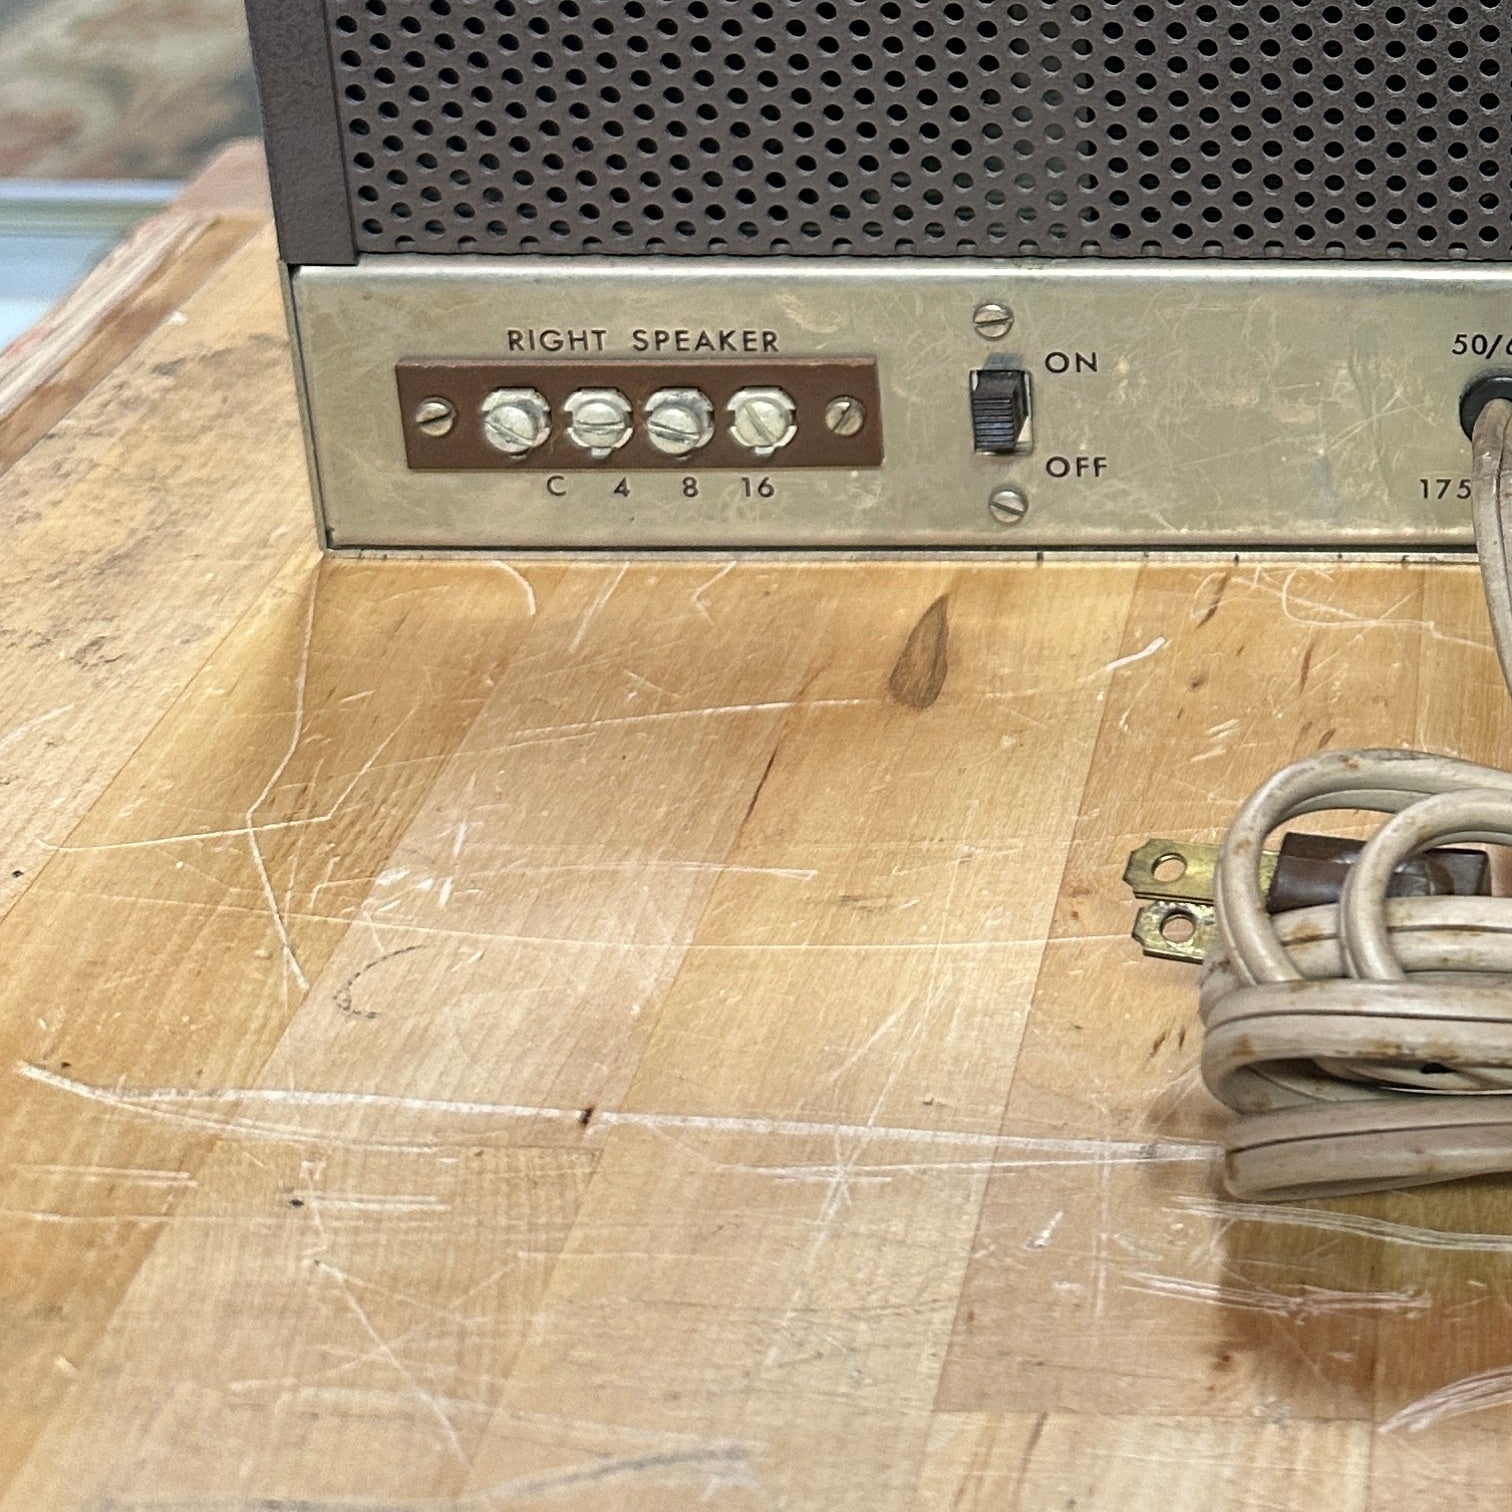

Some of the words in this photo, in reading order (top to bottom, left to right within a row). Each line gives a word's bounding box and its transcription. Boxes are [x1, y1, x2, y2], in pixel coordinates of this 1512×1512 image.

[507, 329, 606, 352] RIGHT
[633, 330, 780, 353] SPEAKER
[1045, 351, 1098, 374] ON
[1045, 456, 1107, 478] OFF
[546, 475, 567, 497] C
[612, 477, 631, 497] 4
[682, 477, 699, 498] 8
[741, 477, 775, 498] 16
[1420, 479, 1471, 500] 175
